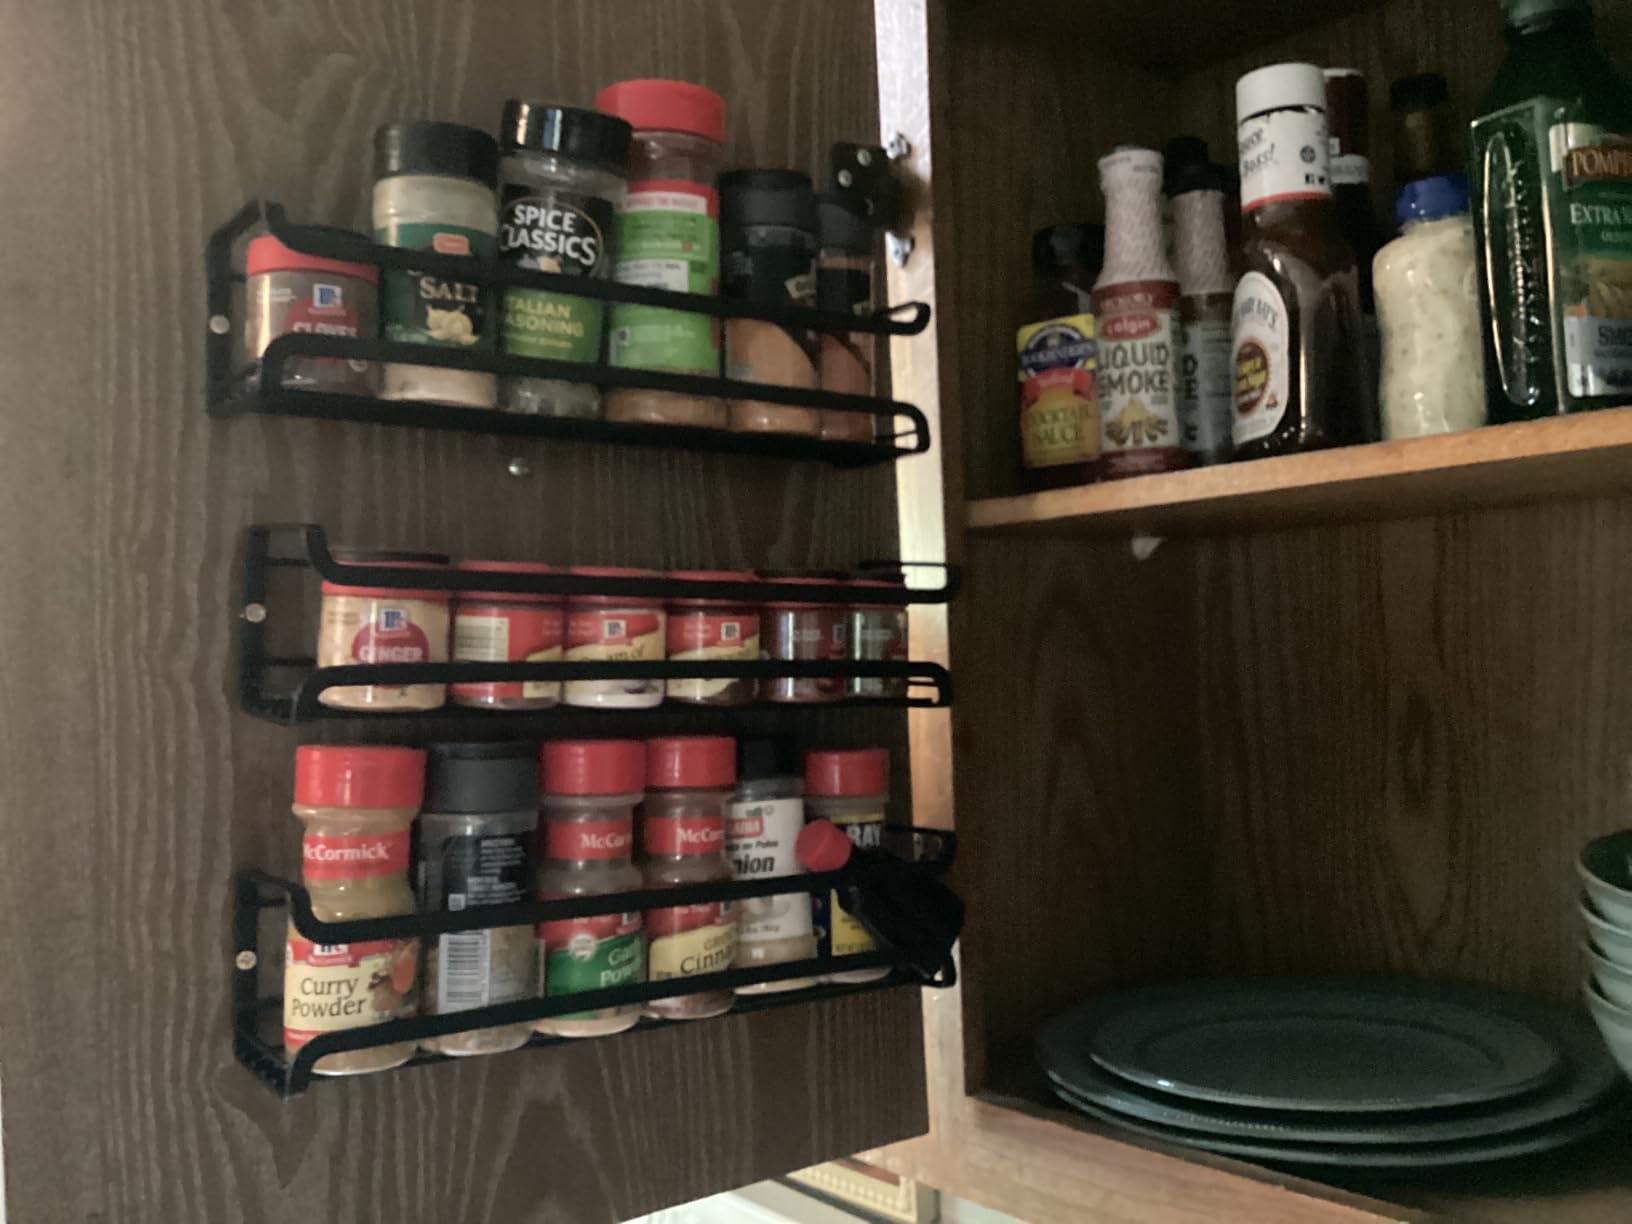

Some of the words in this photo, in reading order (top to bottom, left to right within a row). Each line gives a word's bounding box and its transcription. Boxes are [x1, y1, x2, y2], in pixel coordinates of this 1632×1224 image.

[513, 204, 577, 233] SPICE
[1569, 203, 1622, 225] EXTRA
[499, 223, 597, 266] CLASSICS
[420, 276, 479, 304] SALT
[1098, 343, 1169, 369] LIQUID
[1099, 370, 1169, 400] SMOKE
[732, 854, 775, 875] nion
[300, 977, 359, 1001] Curry
[290, 997, 367, 1018] Powder
